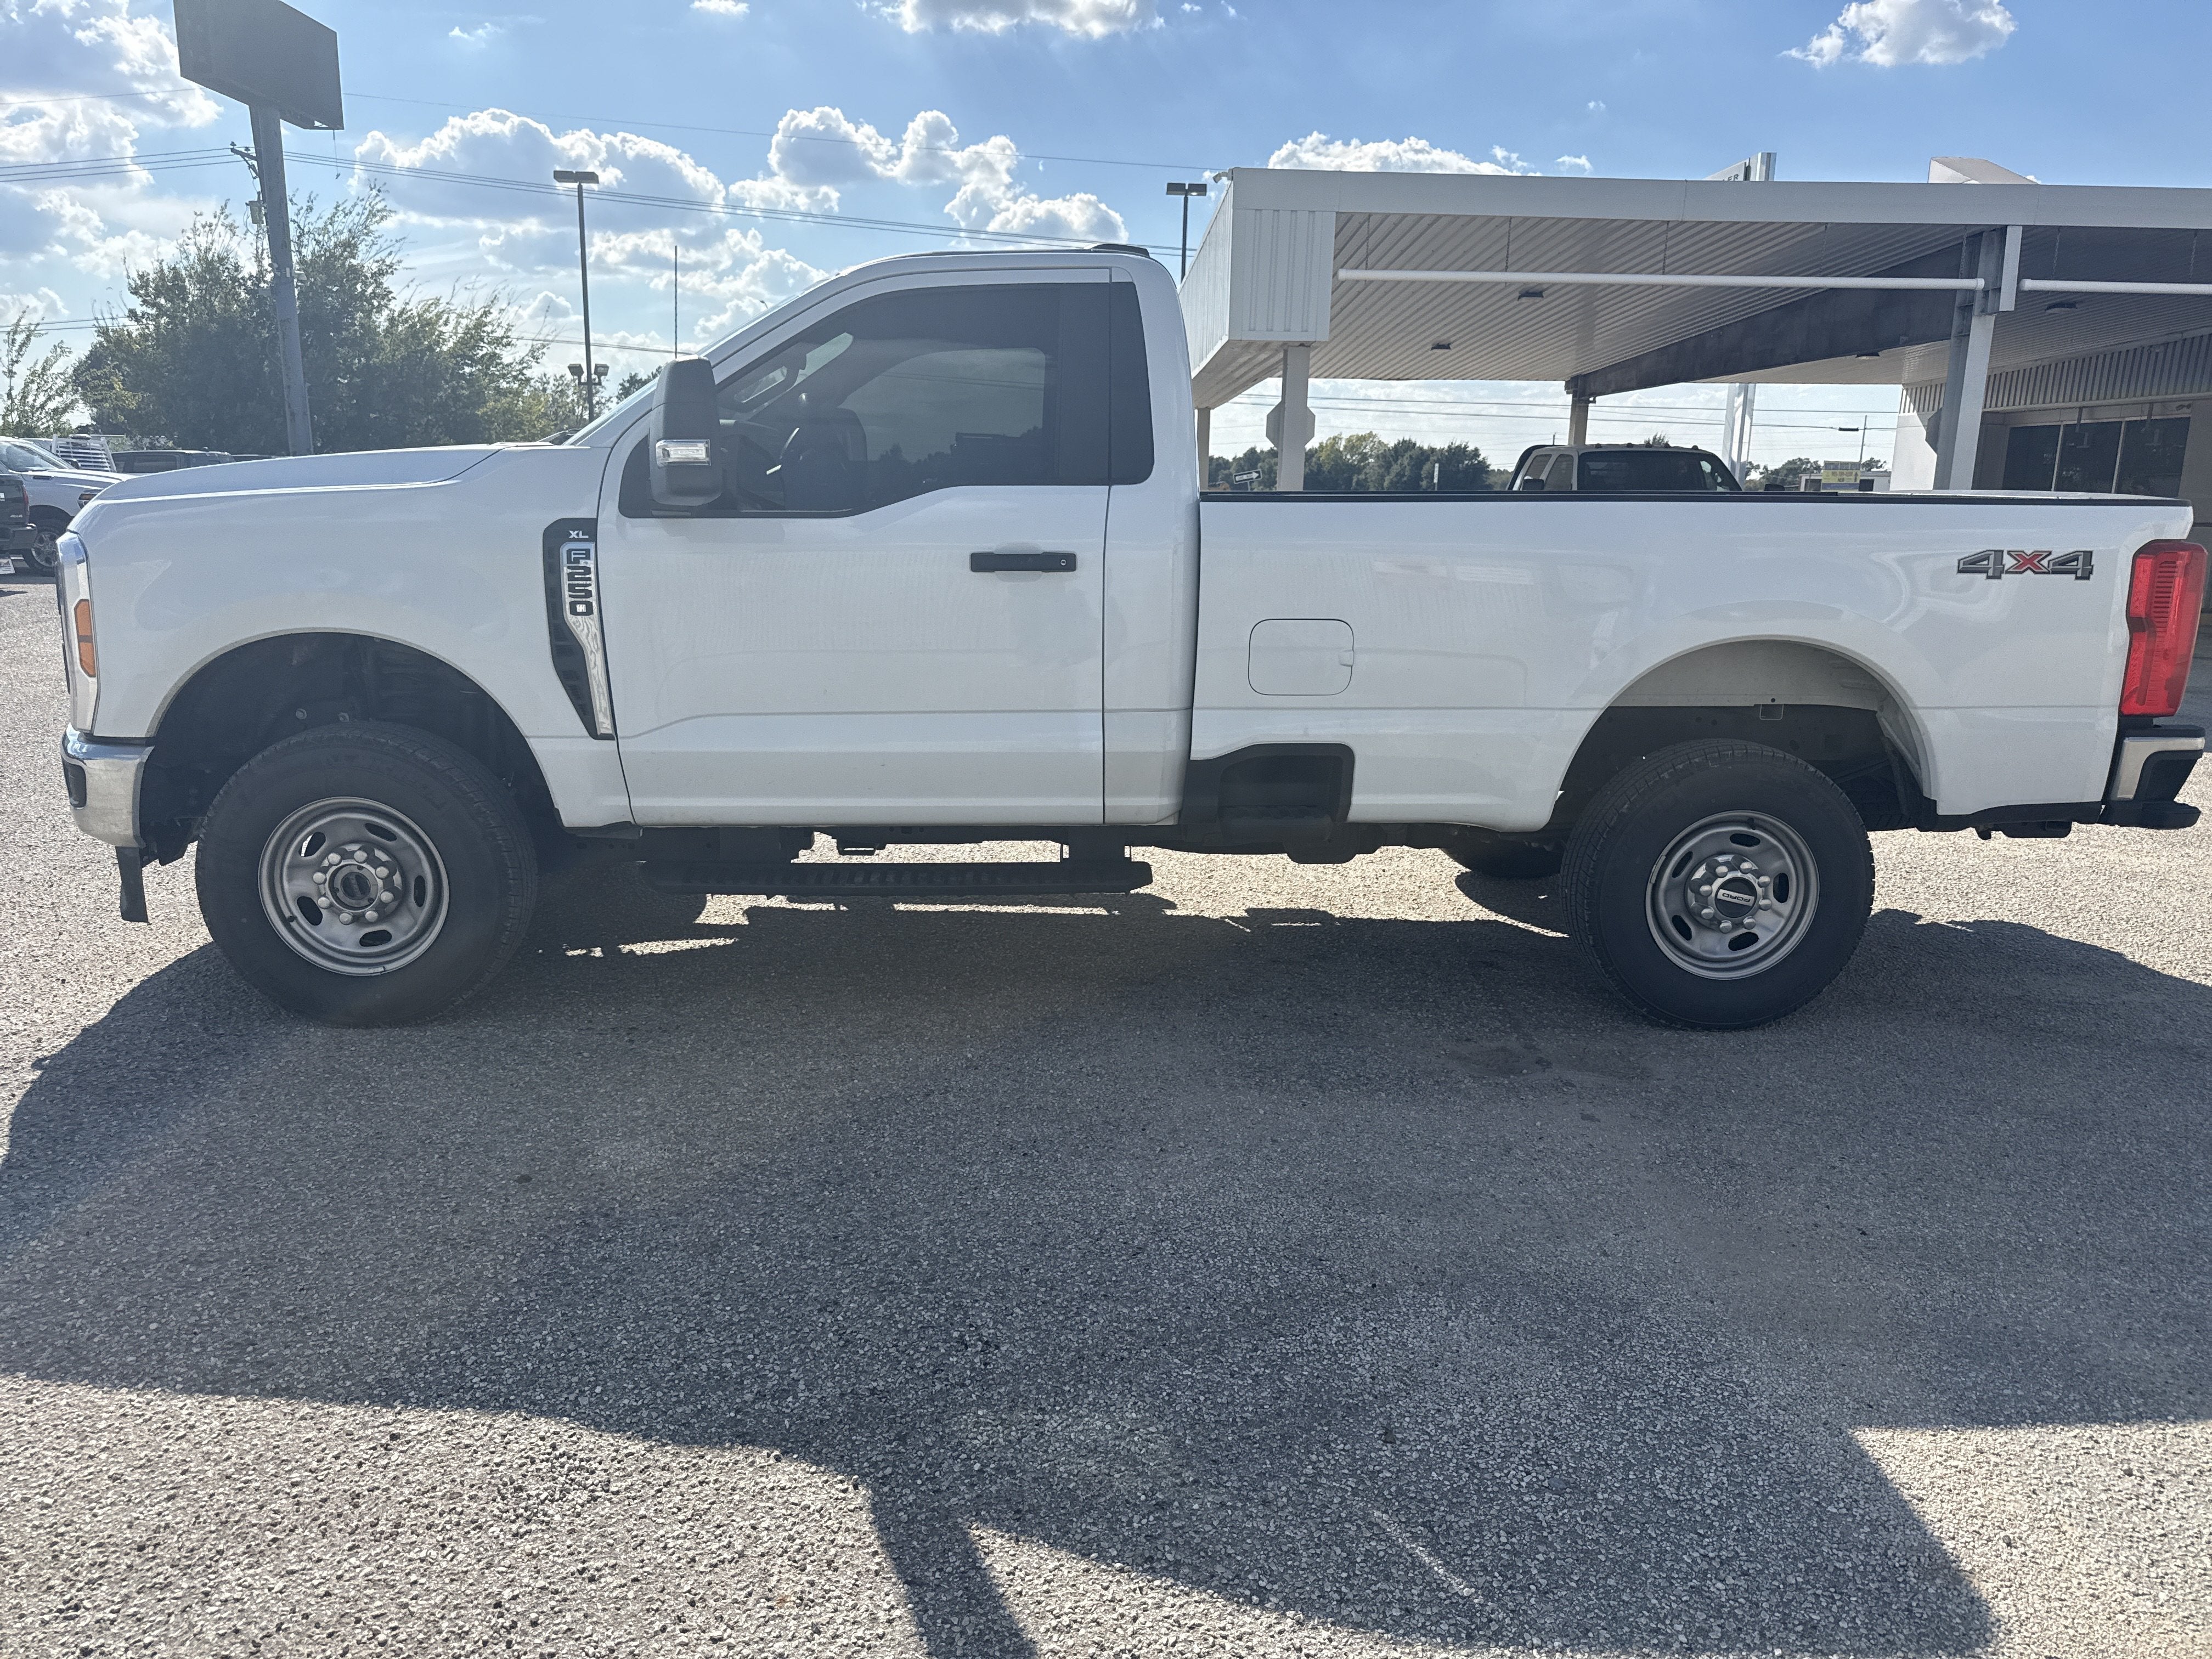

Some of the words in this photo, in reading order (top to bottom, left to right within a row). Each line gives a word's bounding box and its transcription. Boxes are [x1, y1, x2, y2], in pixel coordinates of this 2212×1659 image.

[569, 530, 589, 538] XL
[1957, 549, 2093, 580] 4X4
[1722, 893, 1751, 902] FORD
